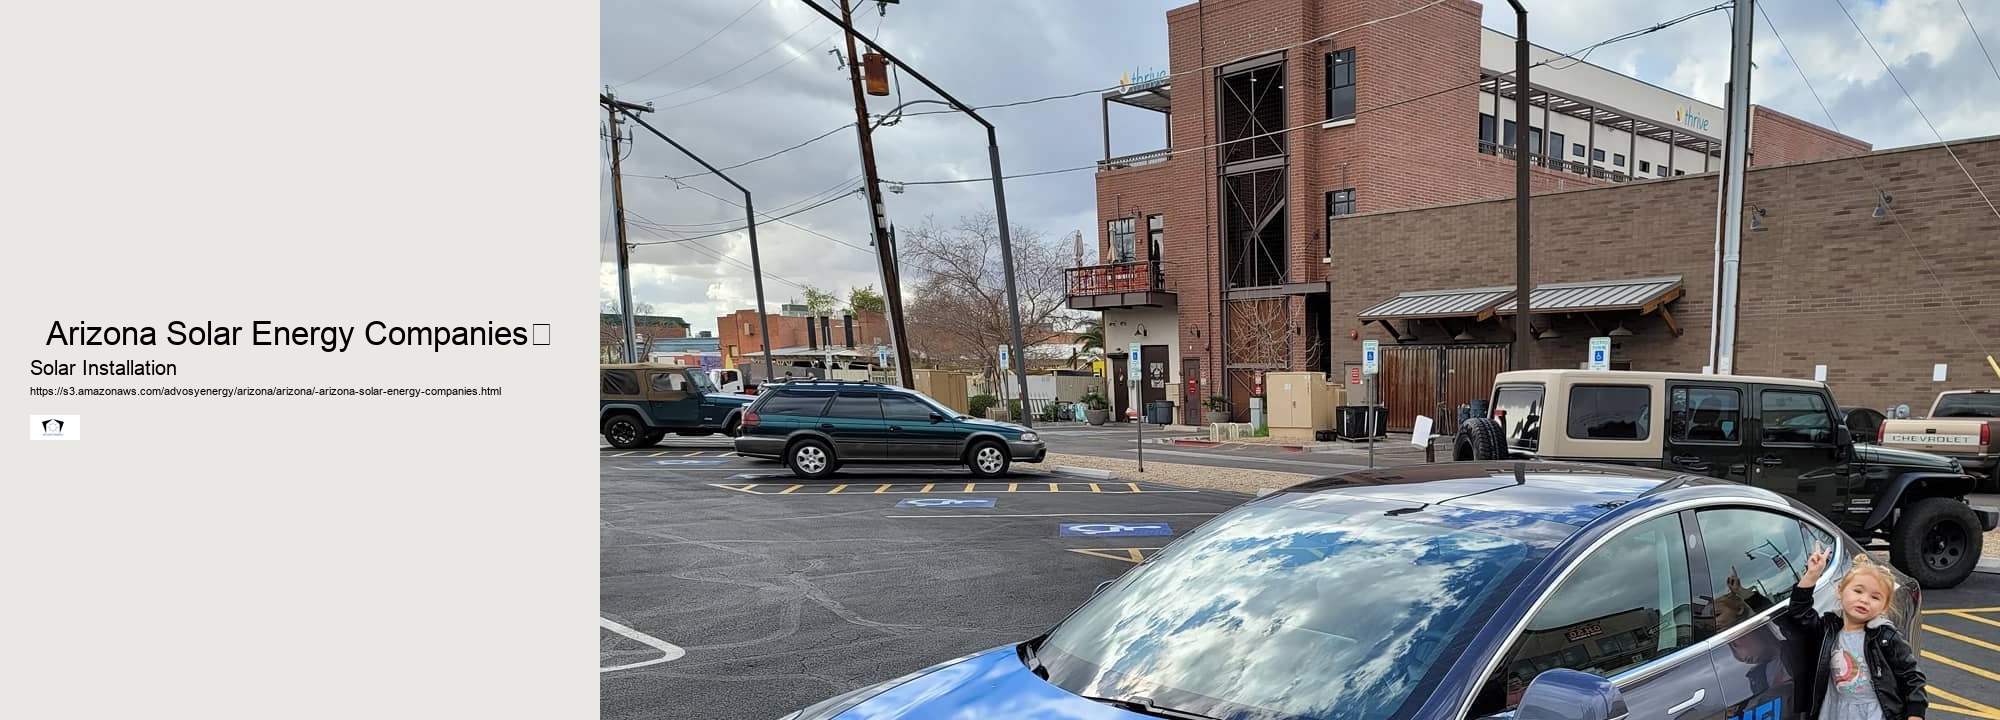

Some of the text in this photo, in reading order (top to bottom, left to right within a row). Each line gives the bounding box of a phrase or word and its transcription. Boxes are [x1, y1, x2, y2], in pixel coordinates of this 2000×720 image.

[1131, 65, 1166, 84] thrive
[1685, 105, 1709, 131] thrive
[1892, 435, 1969, 444] CHEVROLET
